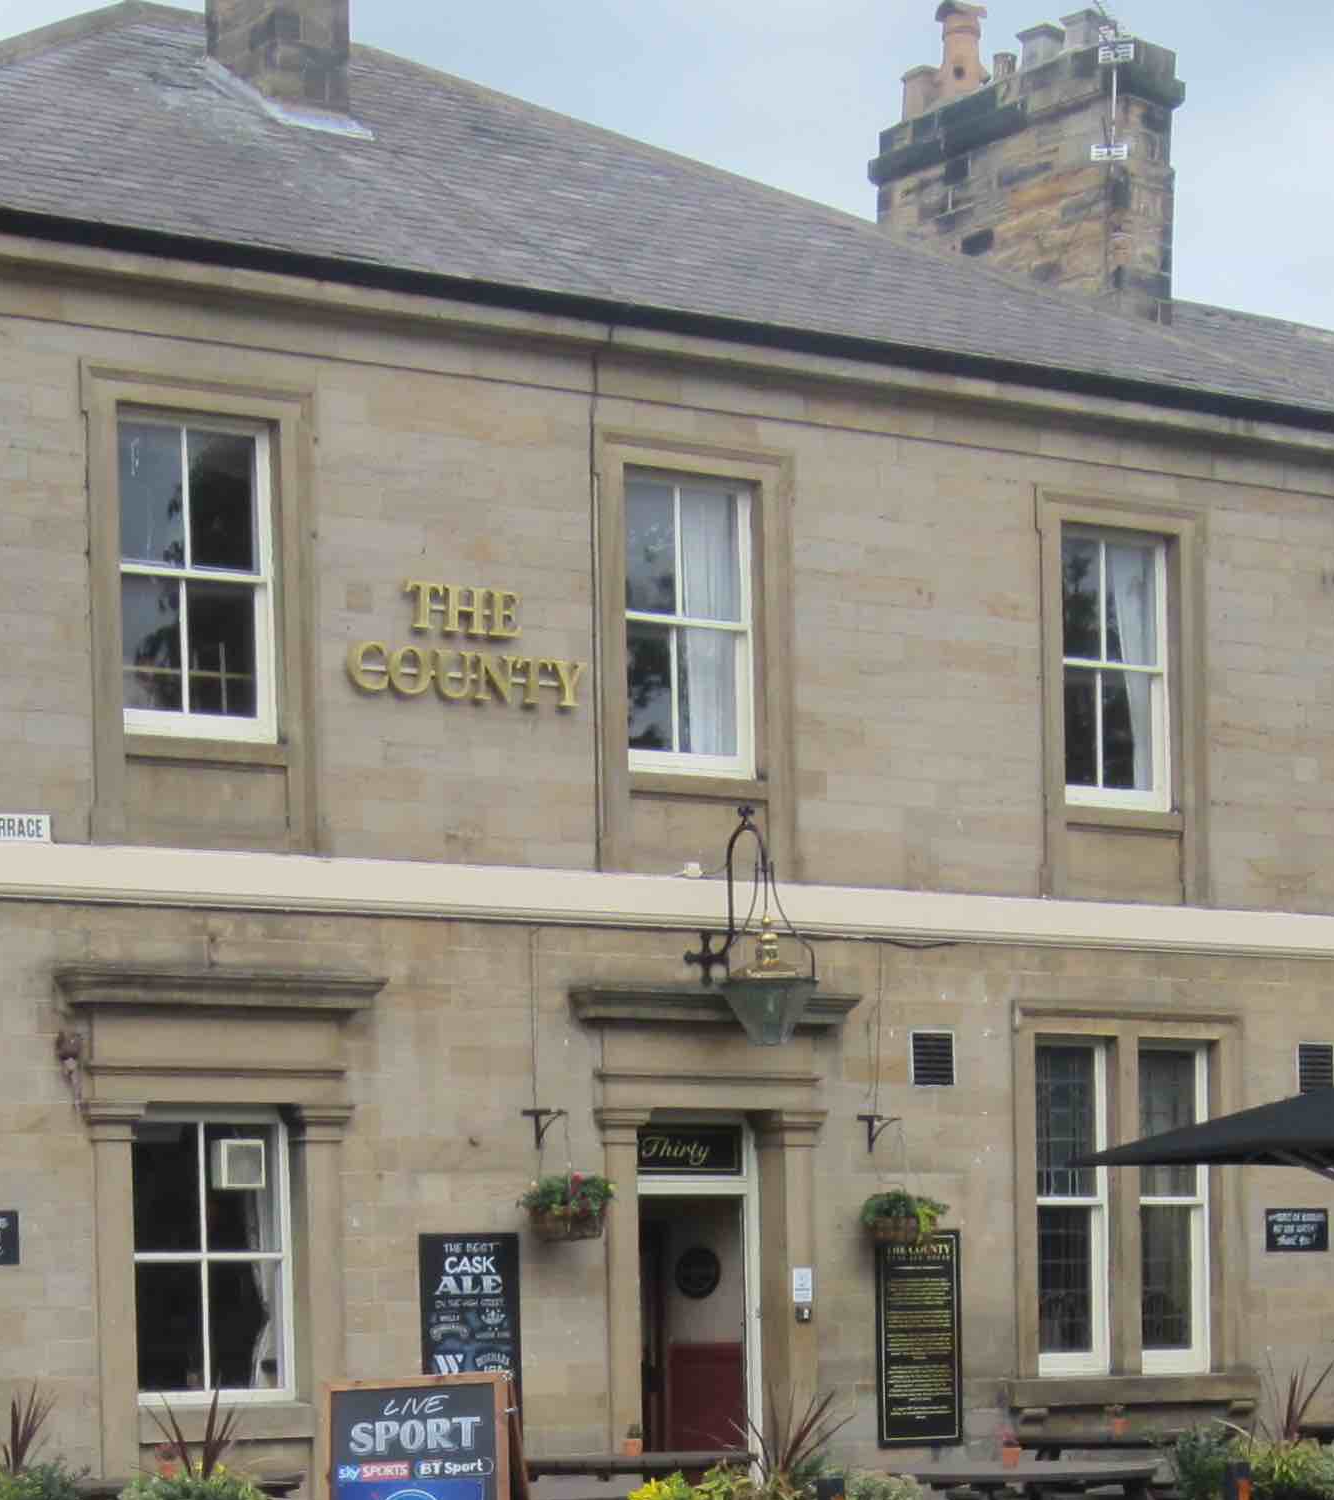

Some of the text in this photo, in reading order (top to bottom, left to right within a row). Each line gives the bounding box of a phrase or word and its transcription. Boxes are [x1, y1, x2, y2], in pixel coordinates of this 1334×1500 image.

[403, 578, 523, 639] THE
[347, 640, 587, 708] COUNTY
[642, 1136, 711, 1166] Thirty
[443, 1242, 463, 1254] THE
[444, 1255, 496, 1274] CASK
[434, 1274, 504, 1295] ALE
[384, 1395, 449, 1416] LIVE
[349, 1416, 483, 1455] SPORT
[338, 1464, 410, 1480] sky SPORTS
[419, 1458, 485, 1476] BT Sport
